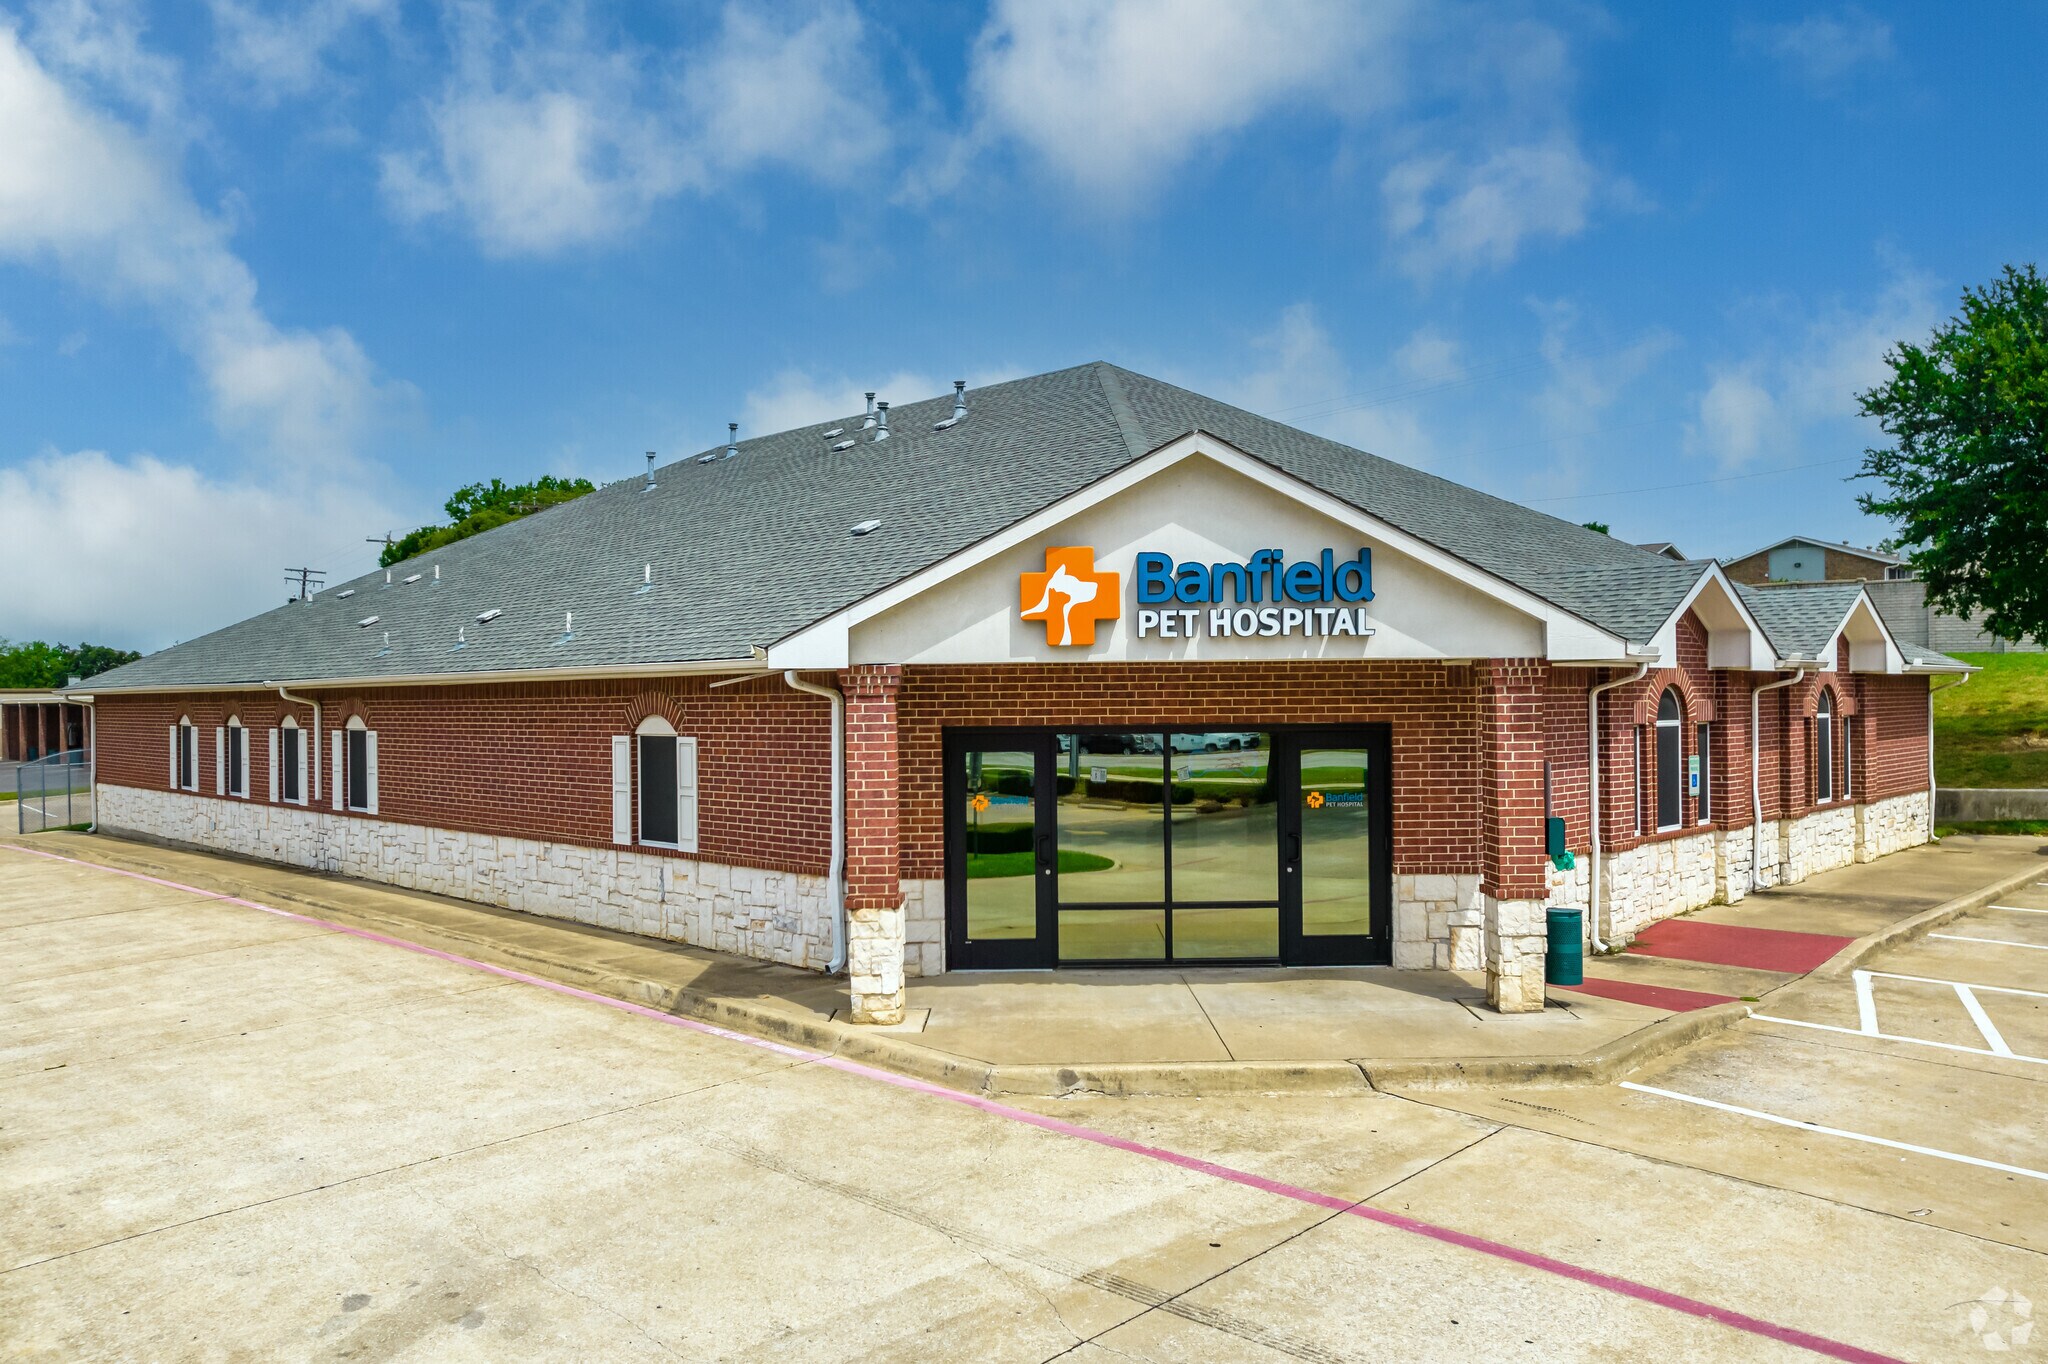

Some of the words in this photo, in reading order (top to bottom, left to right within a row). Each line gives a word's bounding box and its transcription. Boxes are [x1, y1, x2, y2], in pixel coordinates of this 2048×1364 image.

[1137, 547, 1376, 604] Banfield
[1137, 608, 1200, 639] PET
[1208, 607, 1376, 638] HOSPITAL
[1325, 792, 1364, 802] Banfield
